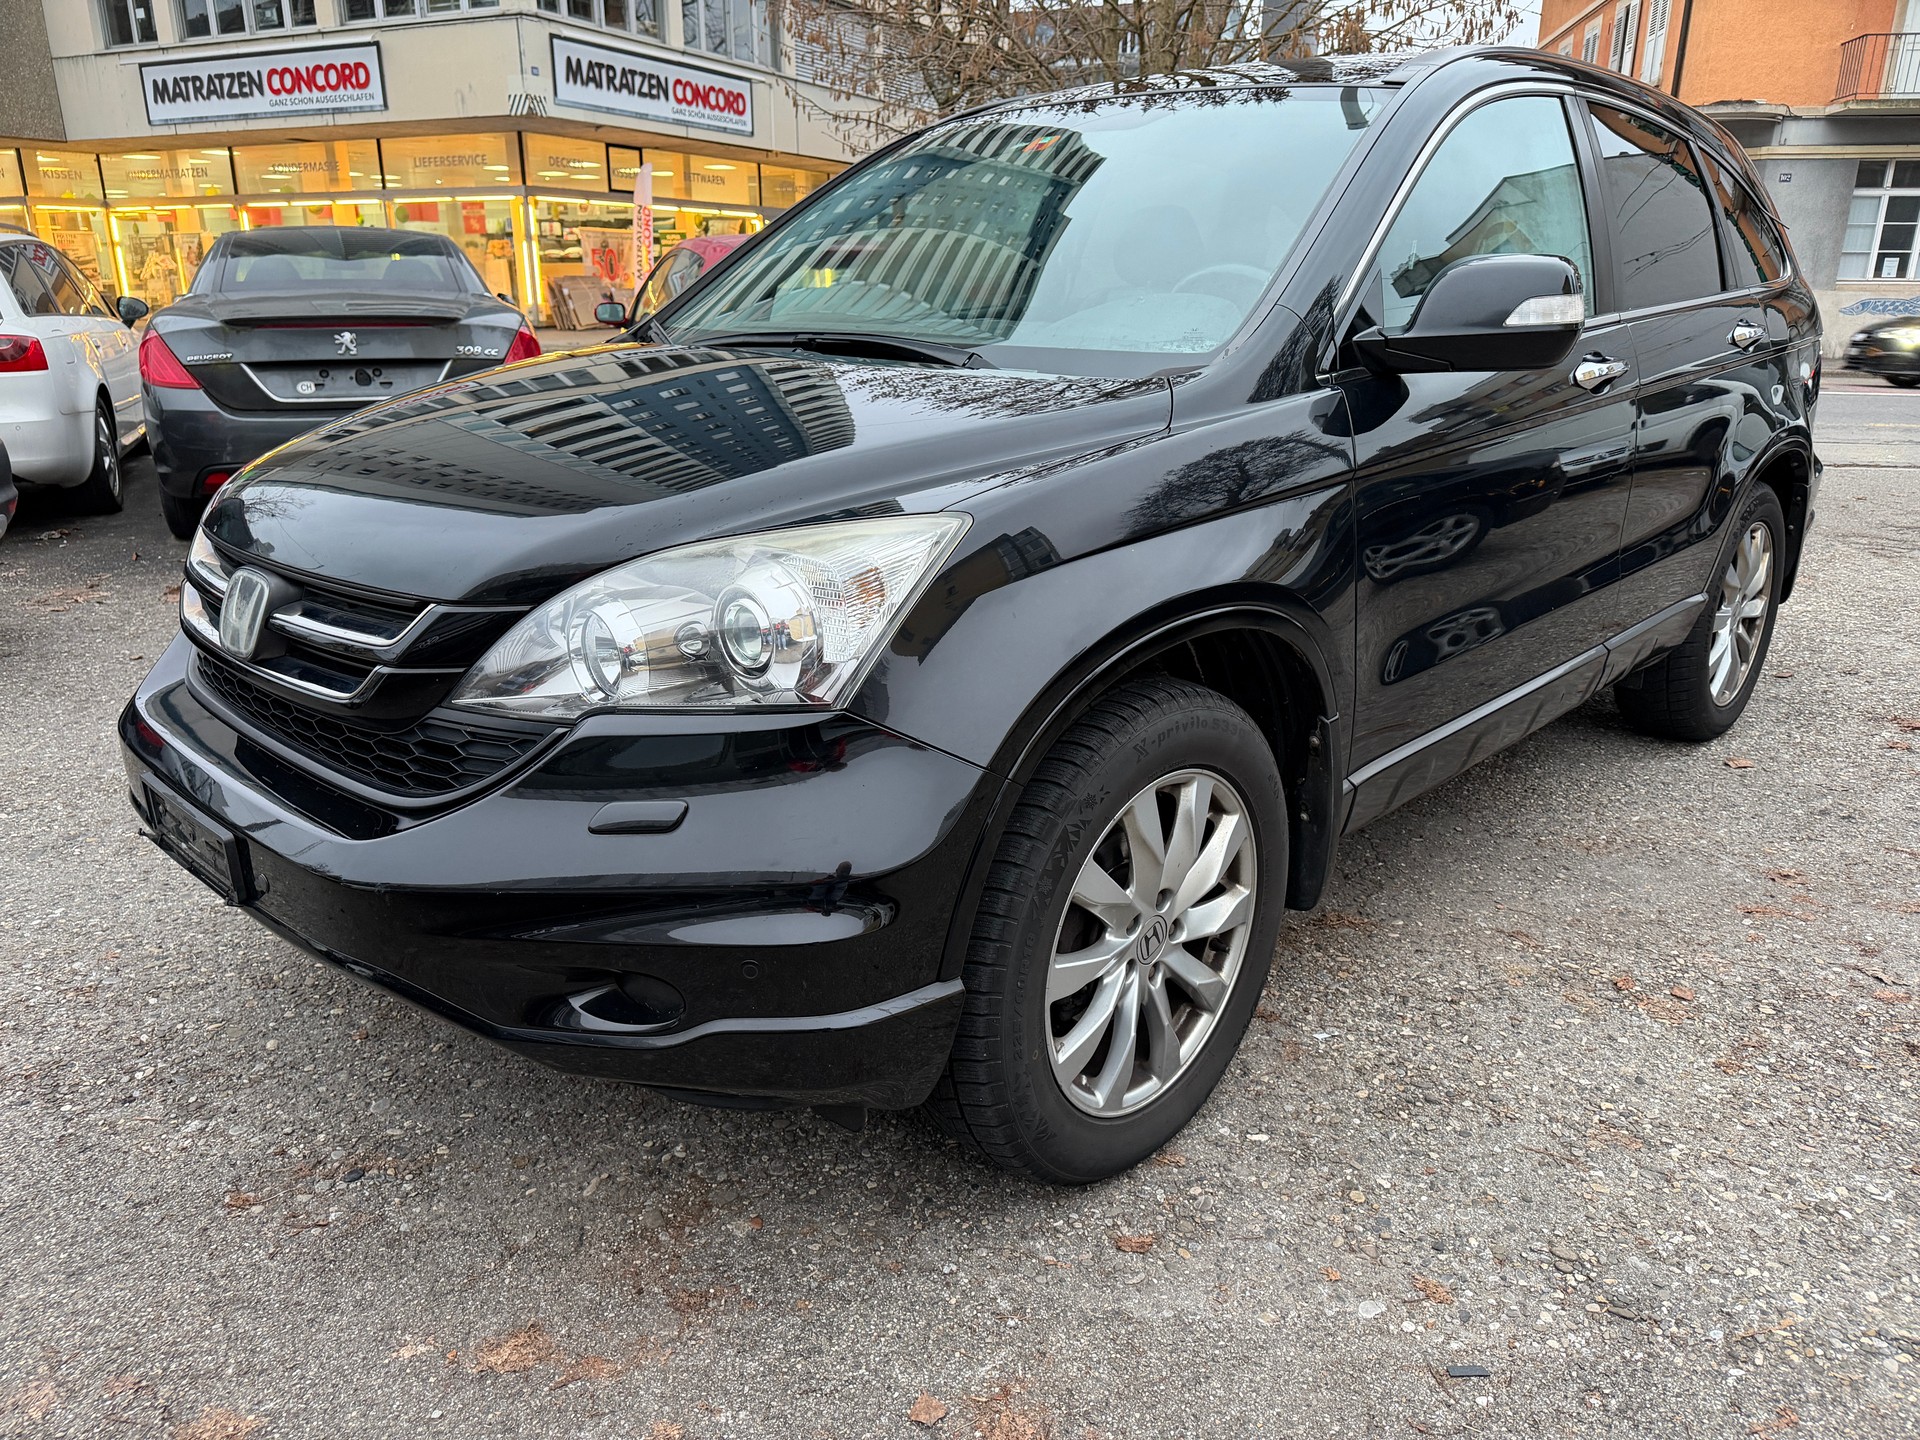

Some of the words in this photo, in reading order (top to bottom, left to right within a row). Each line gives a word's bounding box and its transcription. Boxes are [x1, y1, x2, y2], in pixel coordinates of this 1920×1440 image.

[153, 69, 265, 105] MATRATZEN
[266, 61, 371, 96] CONCORD
[565, 55, 669, 102] MATRATZEN
[672, 78, 747, 116] CONCORD
[269, 98, 289, 108] GANZ
[315, 92, 375, 104] AUSGESCHLAFEN
[413, 154, 488, 168] LIEFERSERVICE
[42, 168, 83, 180] KISSEN
[186, 352, 233, 362] PEUGEOT
[454, 345, 482, 356] 308
[300, 383, 313, 392] CH
